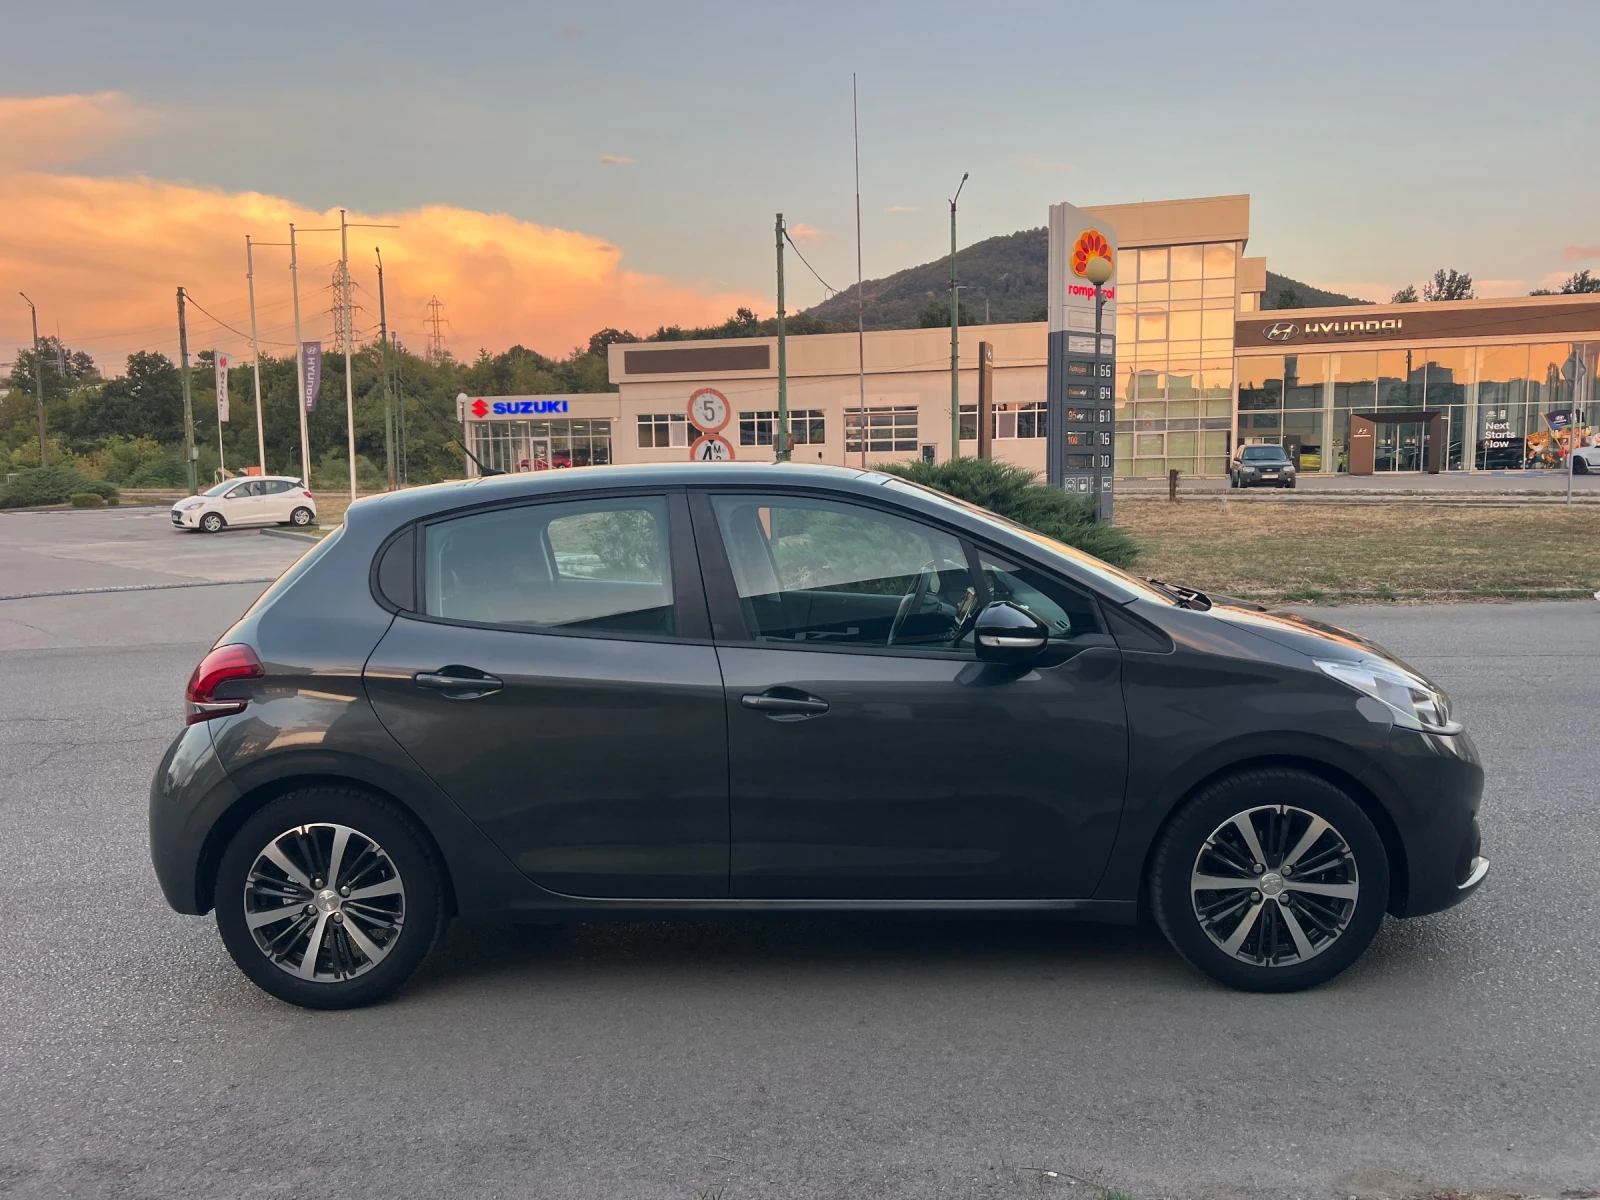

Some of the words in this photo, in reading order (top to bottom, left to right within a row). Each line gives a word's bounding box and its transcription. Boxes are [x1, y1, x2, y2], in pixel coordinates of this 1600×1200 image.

[1068, 285, 1114, 300] romprol
[1305, 319, 1402, 338] HYUNDAI
[306, 357, 315, 406] HYUNDAI
[493, 400, 568, 414] SUZUKI
[704, 401, 715, 421] 5
[1485, 421, 1510, 430] Next
[1068, 436, 1078, 444] 100
[1485, 431, 1515, 439] Starts
